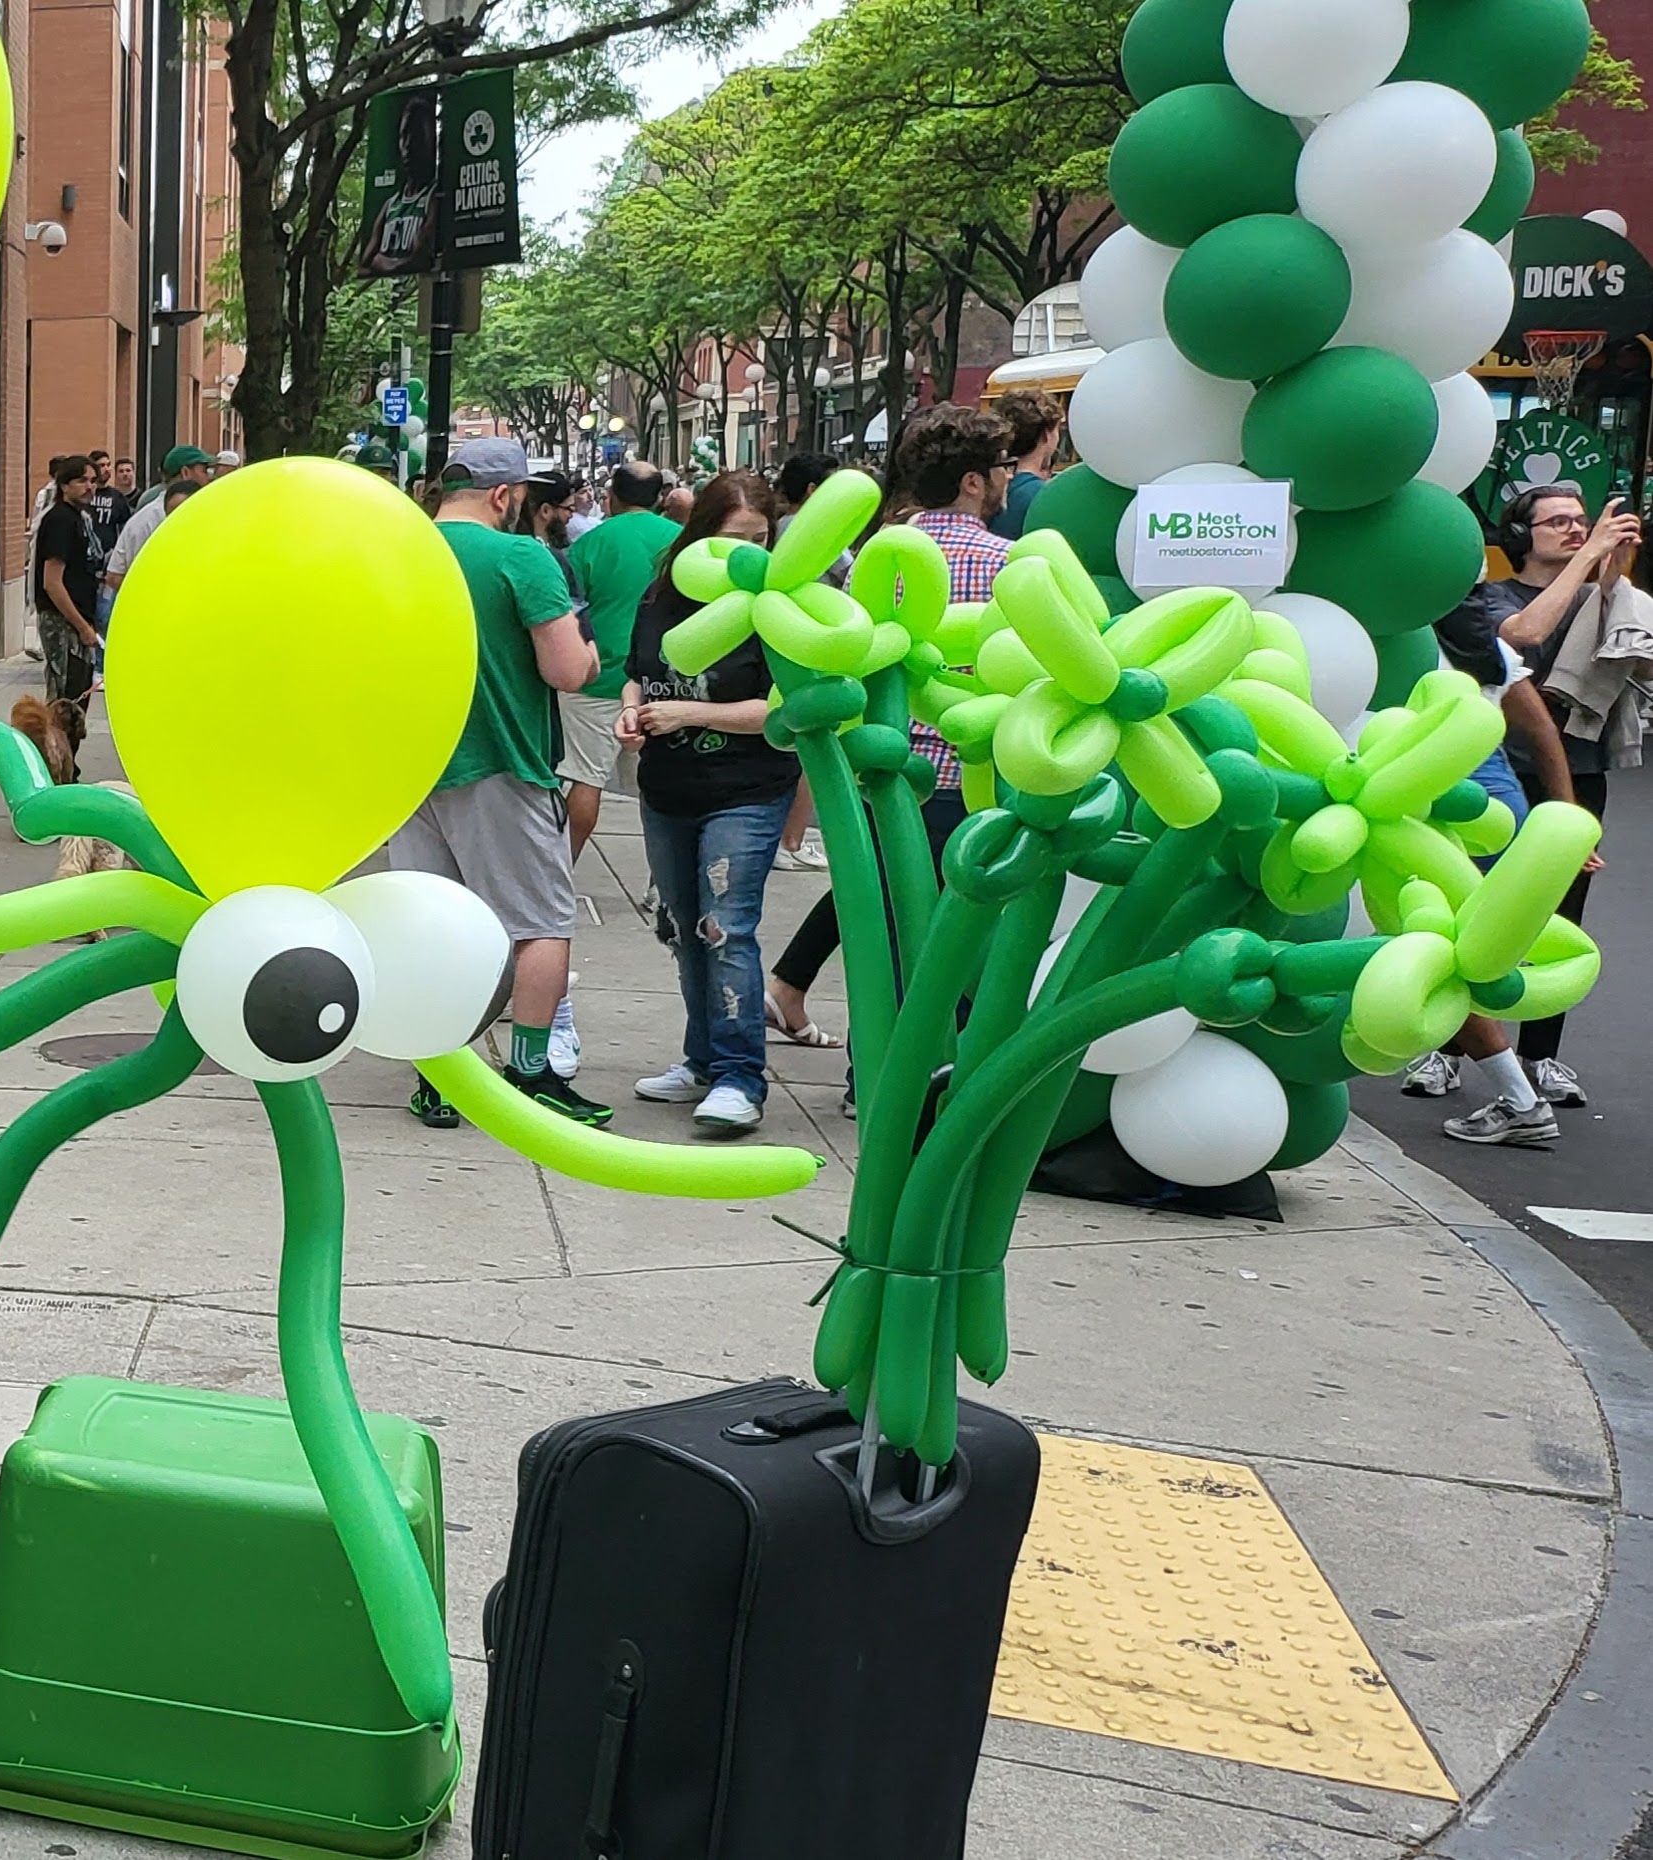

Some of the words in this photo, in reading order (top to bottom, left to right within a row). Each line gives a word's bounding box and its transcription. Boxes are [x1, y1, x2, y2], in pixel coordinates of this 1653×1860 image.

[459, 159, 500, 188] CELTICS
[455, 182, 506, 212] PLAYOFFS
[1523, 261, 1626, 299] DICK'S
[96, 507, 112, 524] 77
[1148, 513, 1193, 539] MB
[1197, 512, 1242, 525] Meet
[1197, 525, 1276, 539] BOSTON
[1158, 547, 1263, 557] meetboston.com
